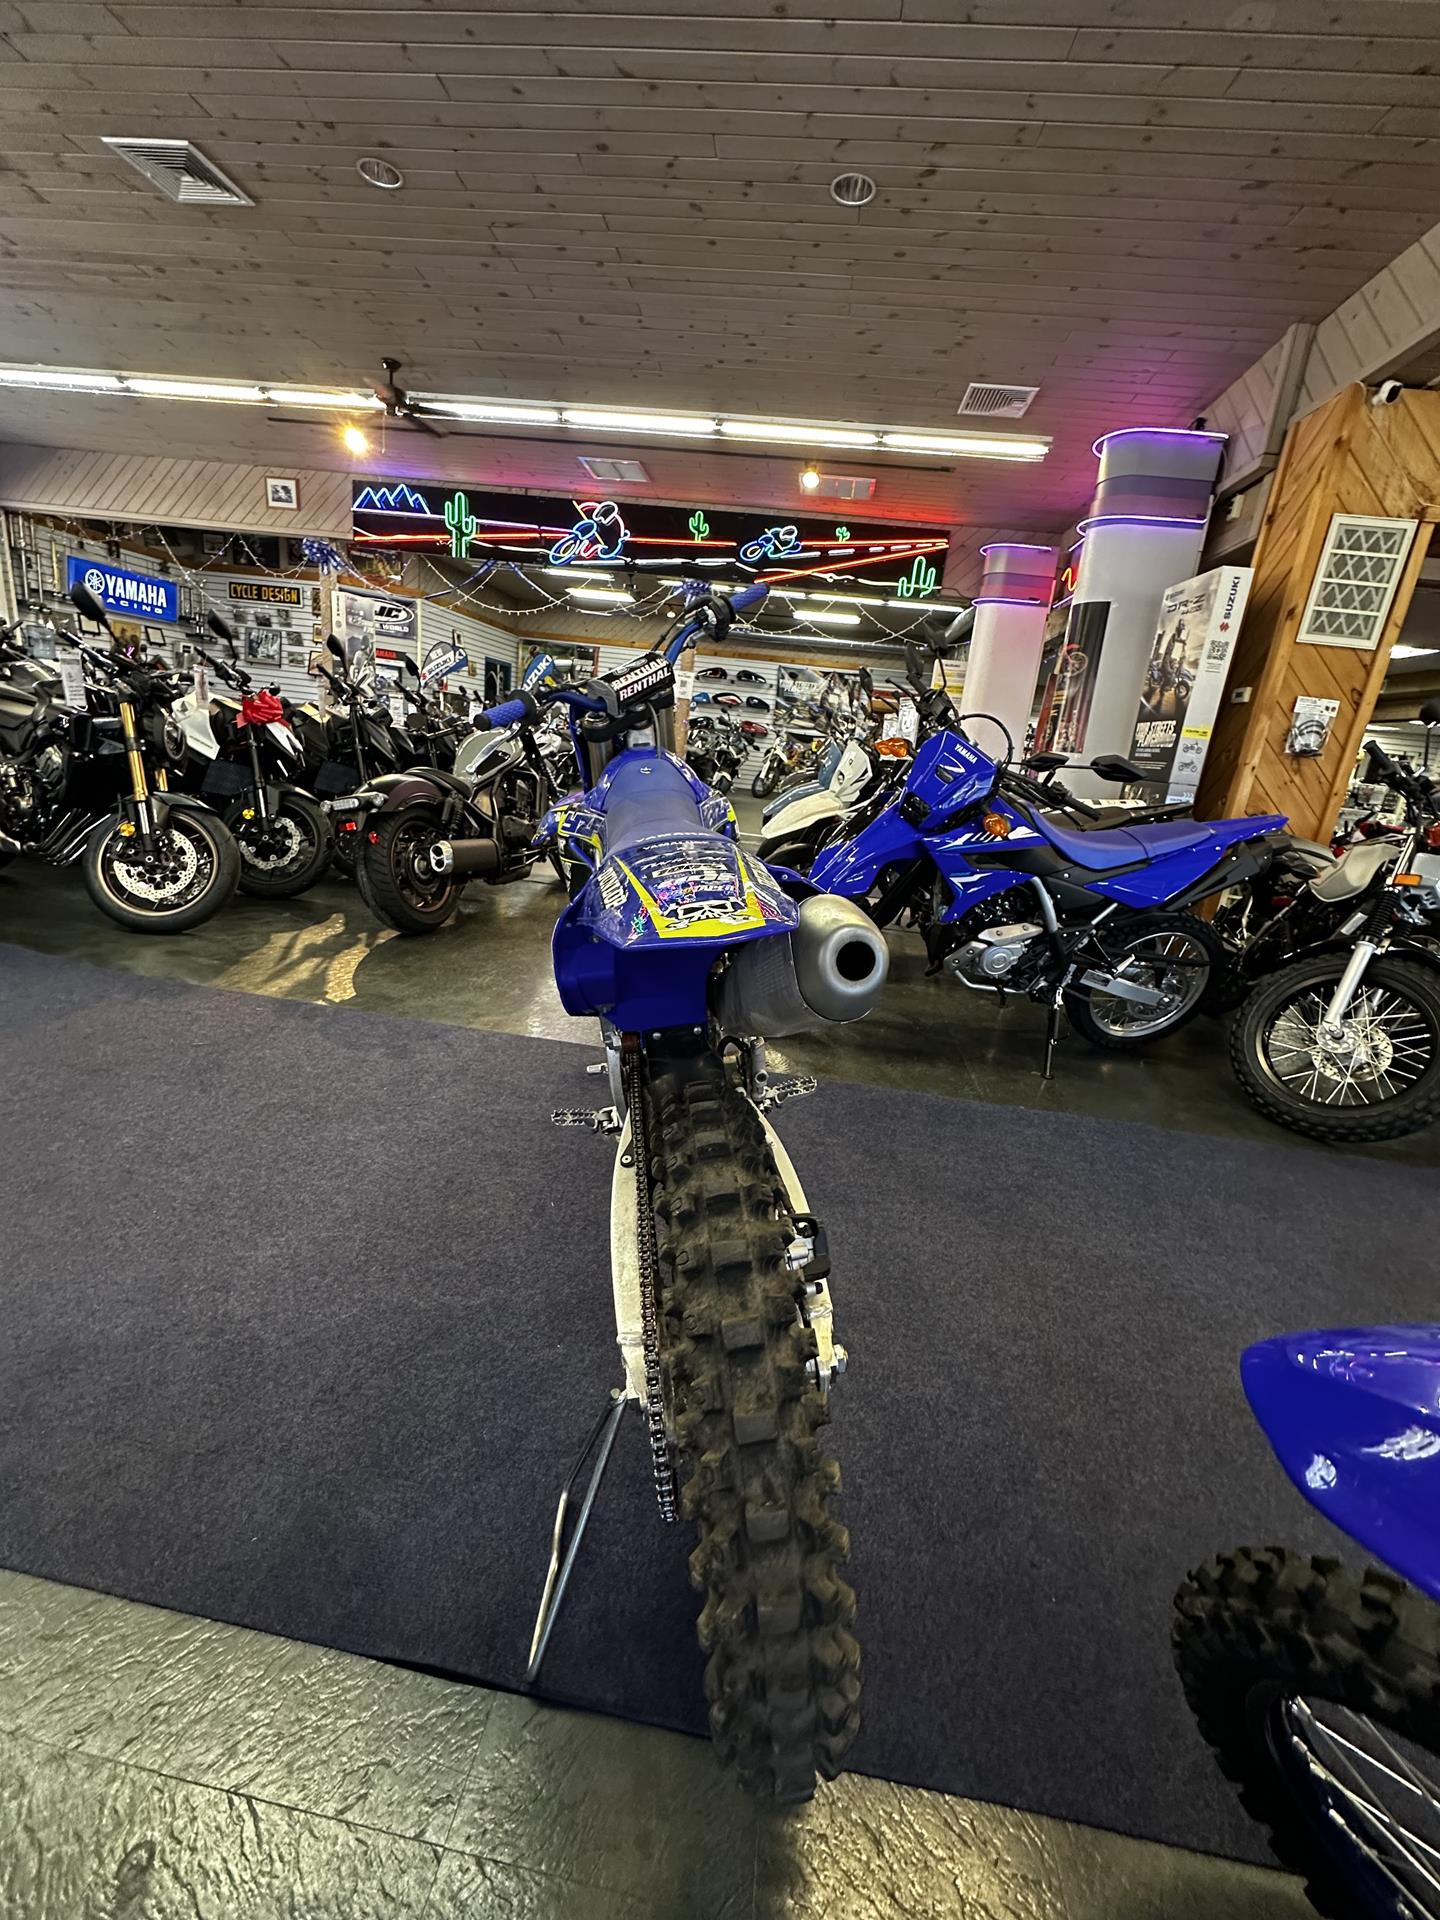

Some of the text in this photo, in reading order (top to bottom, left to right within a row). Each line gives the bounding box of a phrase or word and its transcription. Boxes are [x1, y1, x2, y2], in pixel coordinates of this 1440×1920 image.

[105, 573, 167, 608] YAMAHA
[230, 584, 298, 603] CYCLE DESIGN
[1224, 576, 1241, 619] SUZUKI
[99, 595, 163, 615] ACING
[375, 605, 403, 619] JC
[382, 623, 409, 633] WORLD
[427, 656, 452, 676] SUZUKI
[611, 657, 670, 691] RENTHAL
[619, 666, 672, 701] RENTHAL
[954, 743, 978, 764] YAMAHA
[635, 832, 712, 843] YAMAHA
[597, 866, 628, 910] DUNLOP
